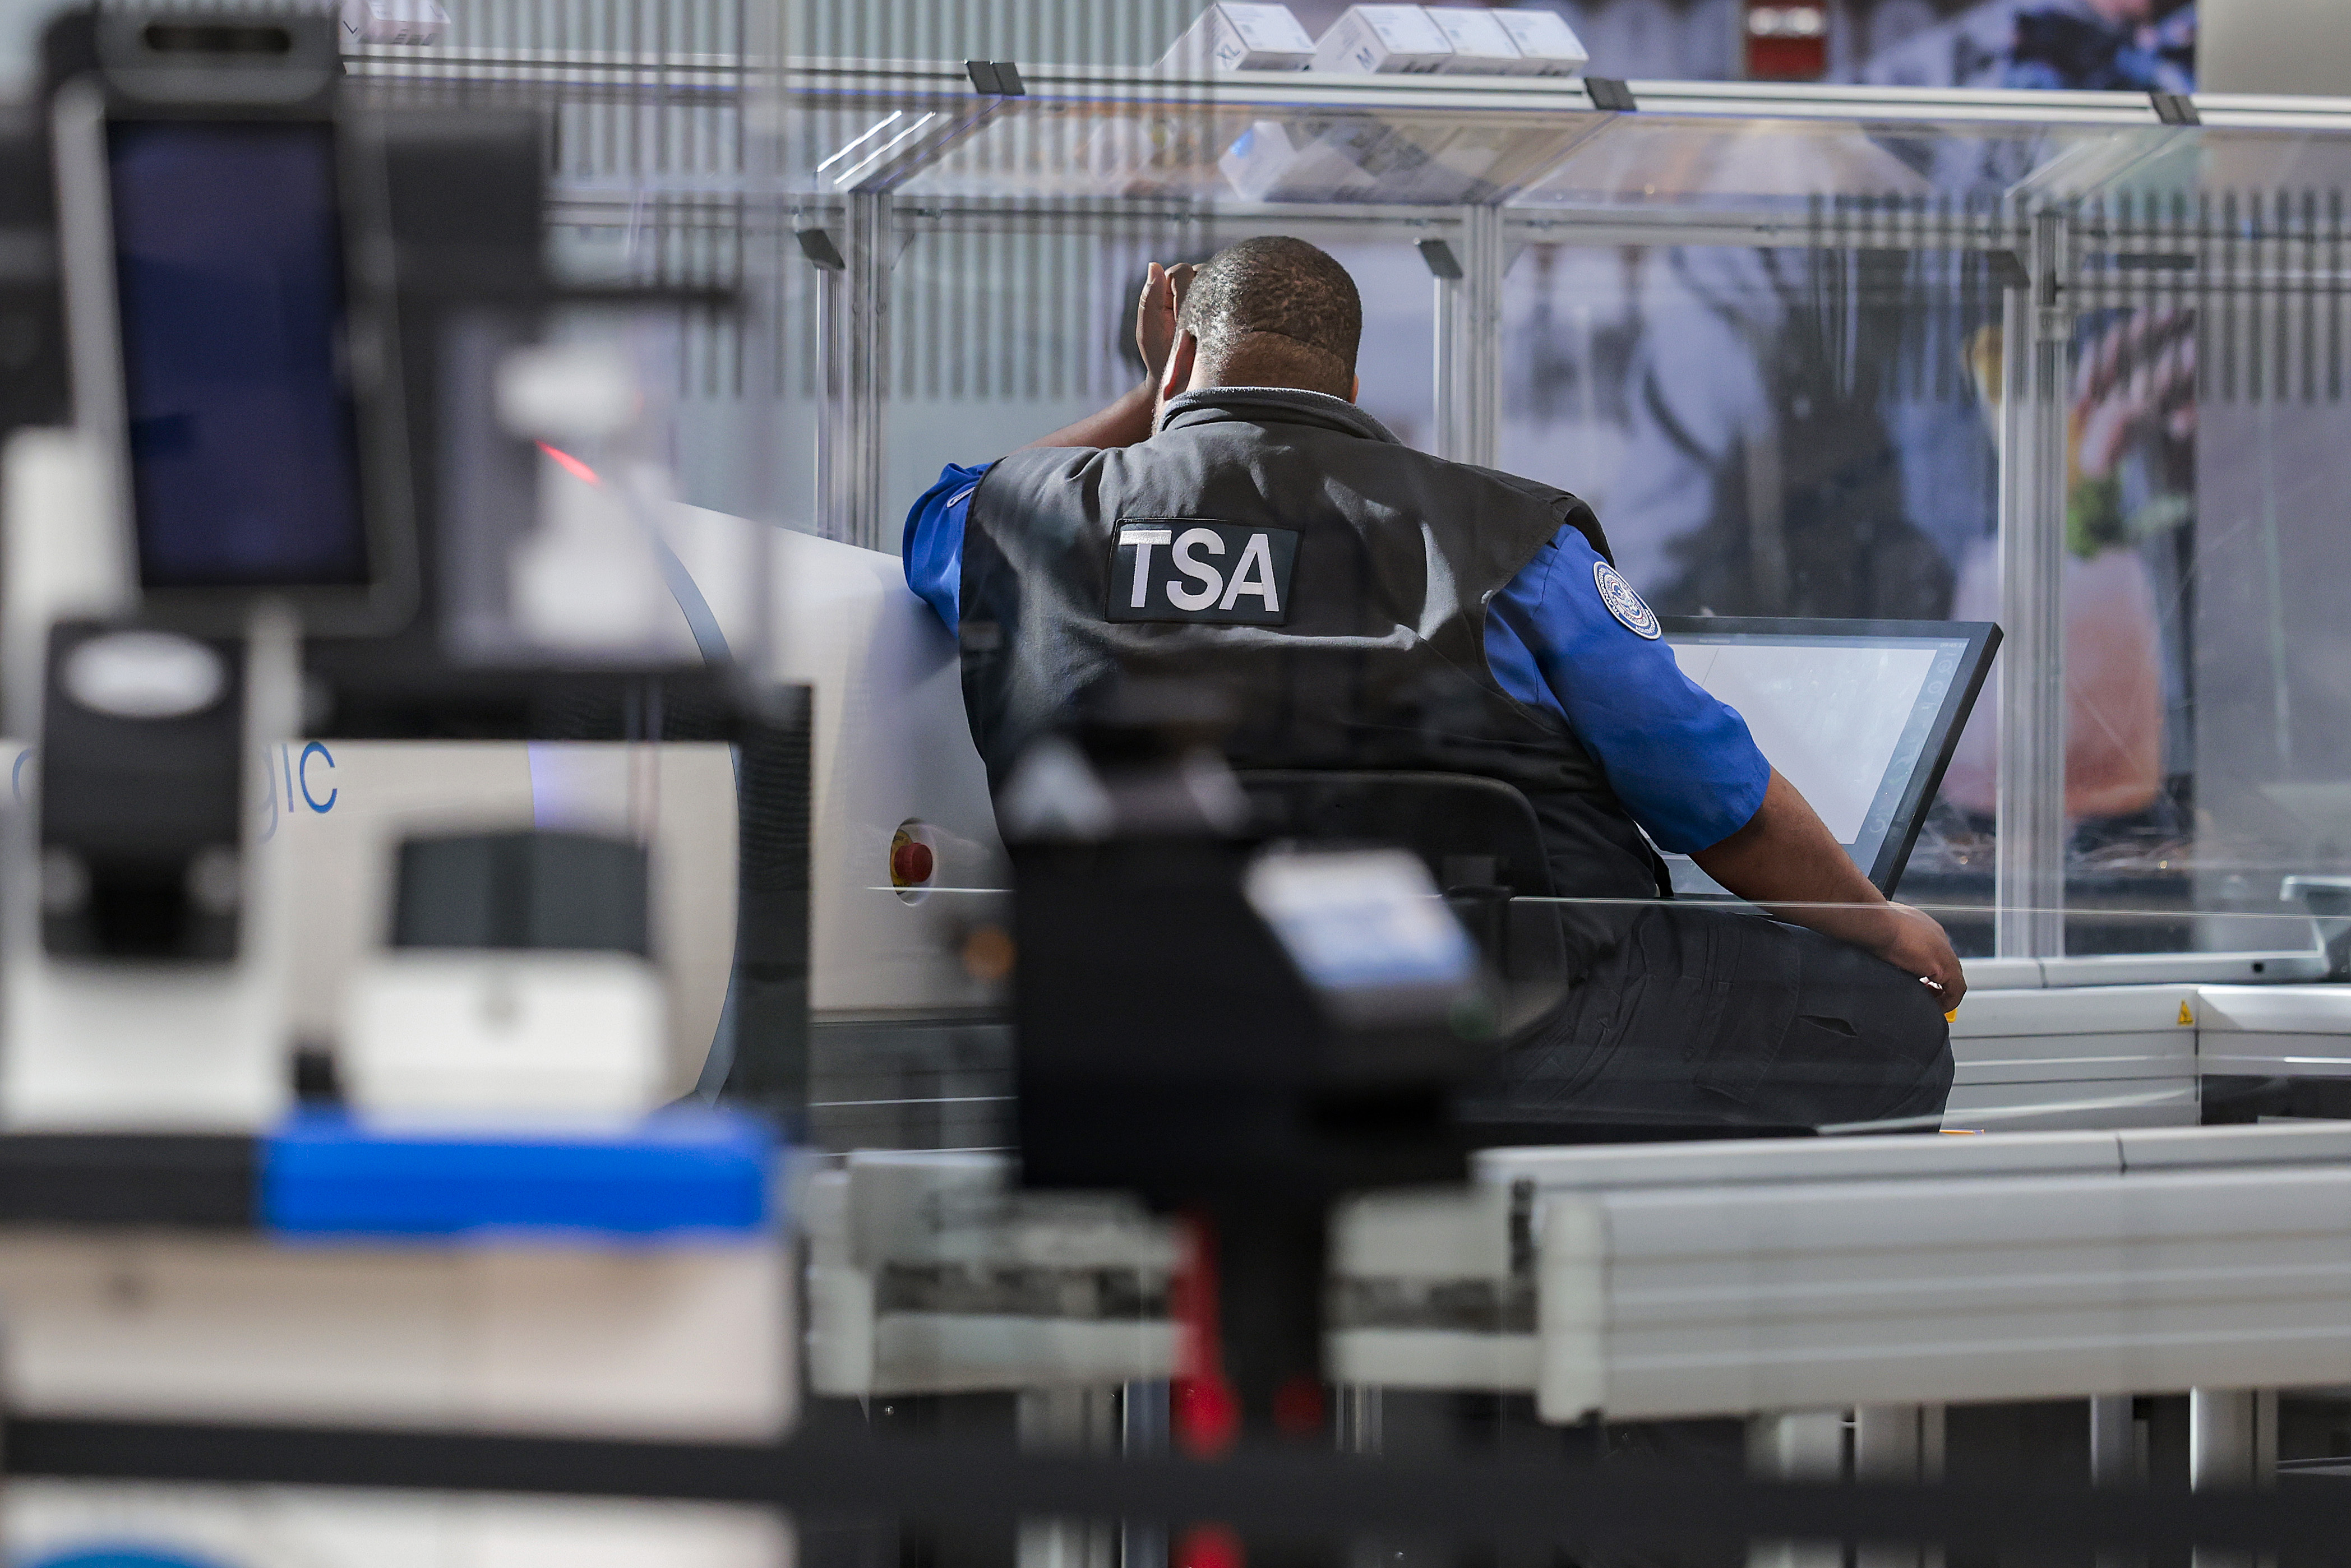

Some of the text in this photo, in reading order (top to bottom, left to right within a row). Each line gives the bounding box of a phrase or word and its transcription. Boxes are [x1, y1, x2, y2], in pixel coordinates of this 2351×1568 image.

[1217, 44, 1240, 67] XL
[1356, 47, 1376, 70] M
[1119, 528, 1280, 612] TSA
